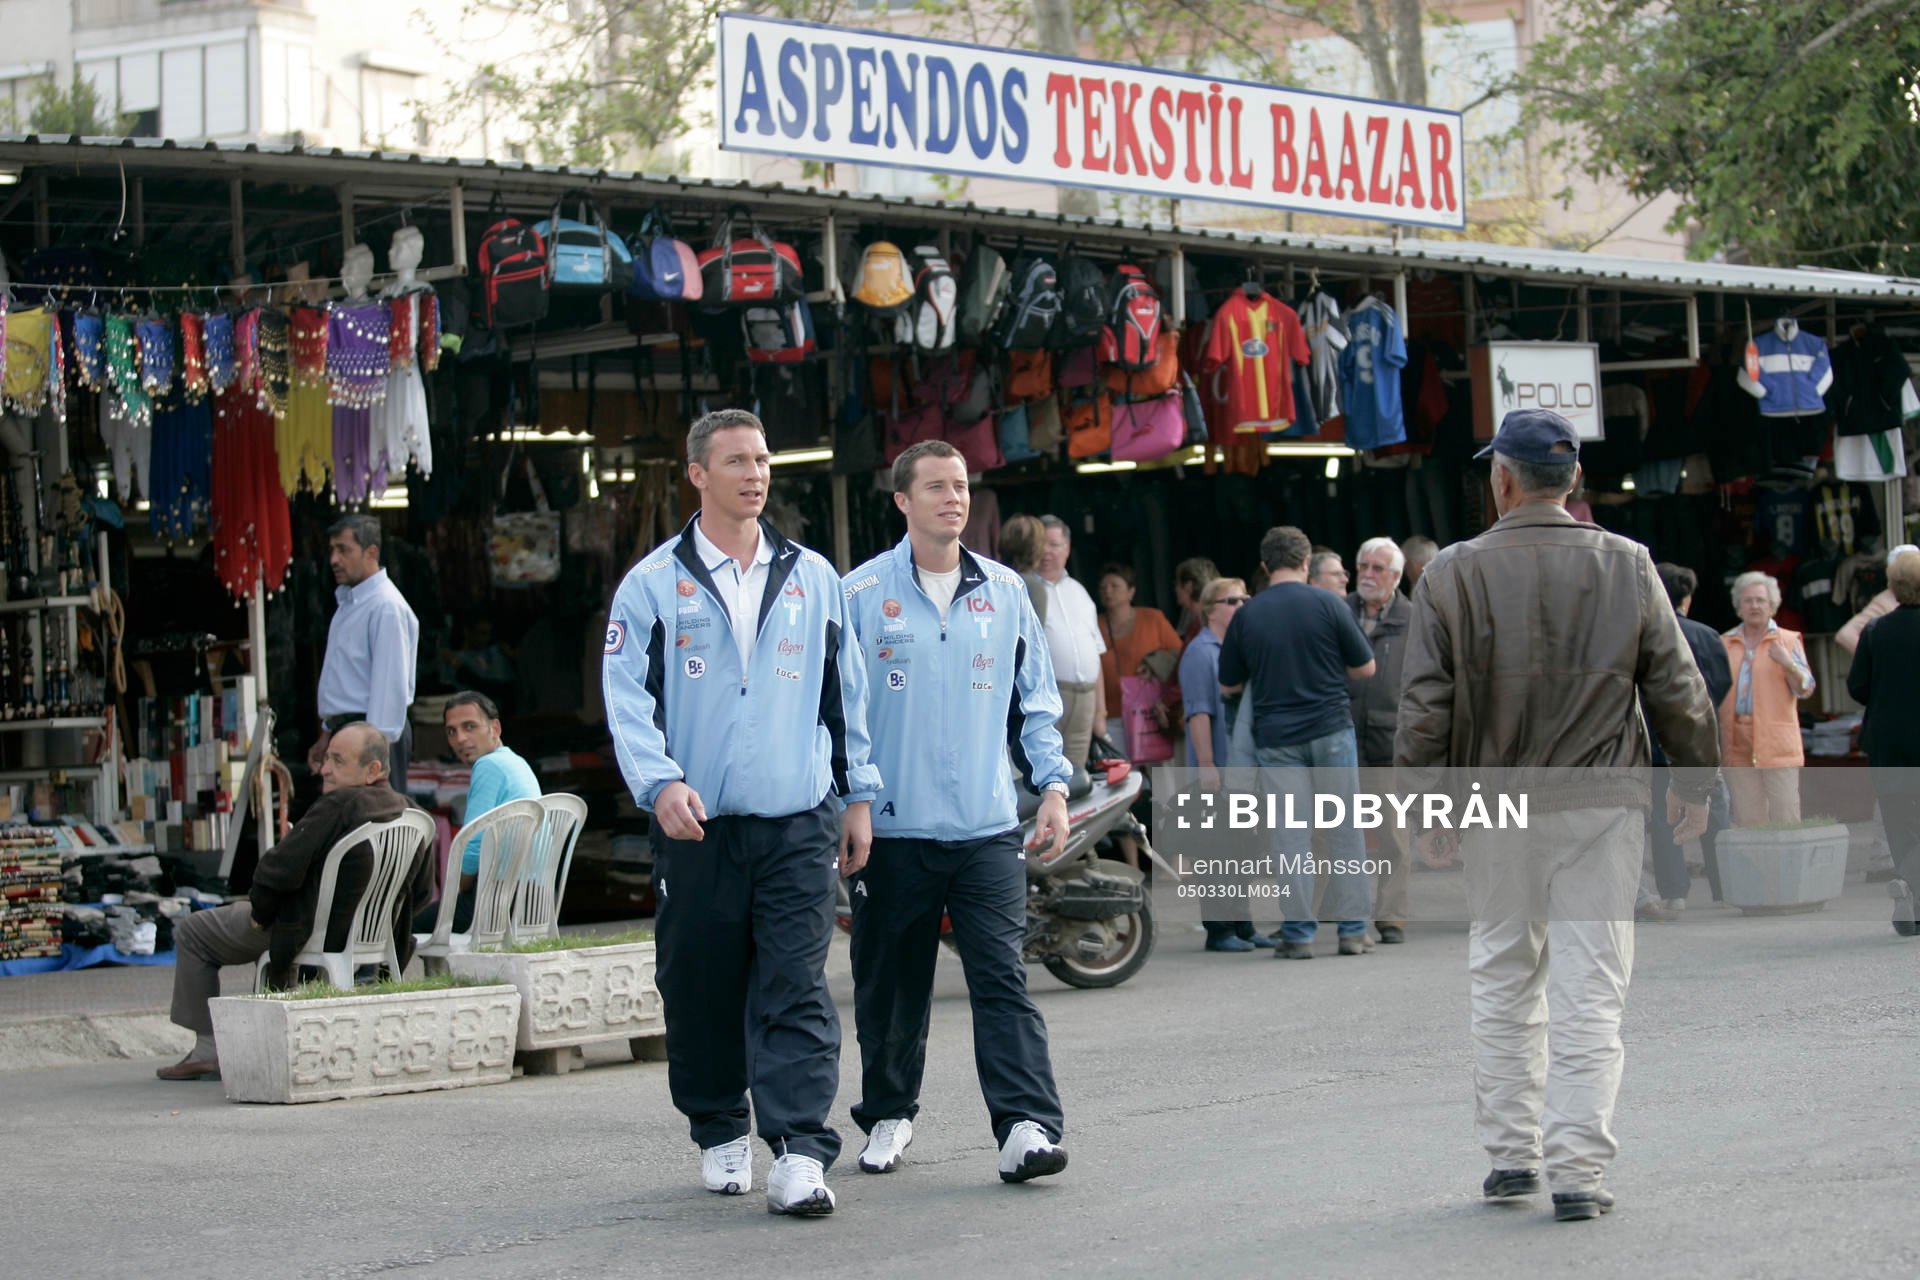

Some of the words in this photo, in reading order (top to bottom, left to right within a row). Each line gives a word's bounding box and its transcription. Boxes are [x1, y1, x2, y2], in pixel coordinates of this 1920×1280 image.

[734, 32, 1029, 165] ASPENDOS
[1046, 71, 1254, 188] TEKSTİL
[1270, 103, 1458, 212] BAAZAR
[1517, 383, 1593, 408] POLO
[783, 582, 805, 598] CA
[845, 573, 880, 600] STADIUM
[966, 597, 996, 613] ICA
[879, 801, 896, 816] A
[855, 880, 868, 897] A
